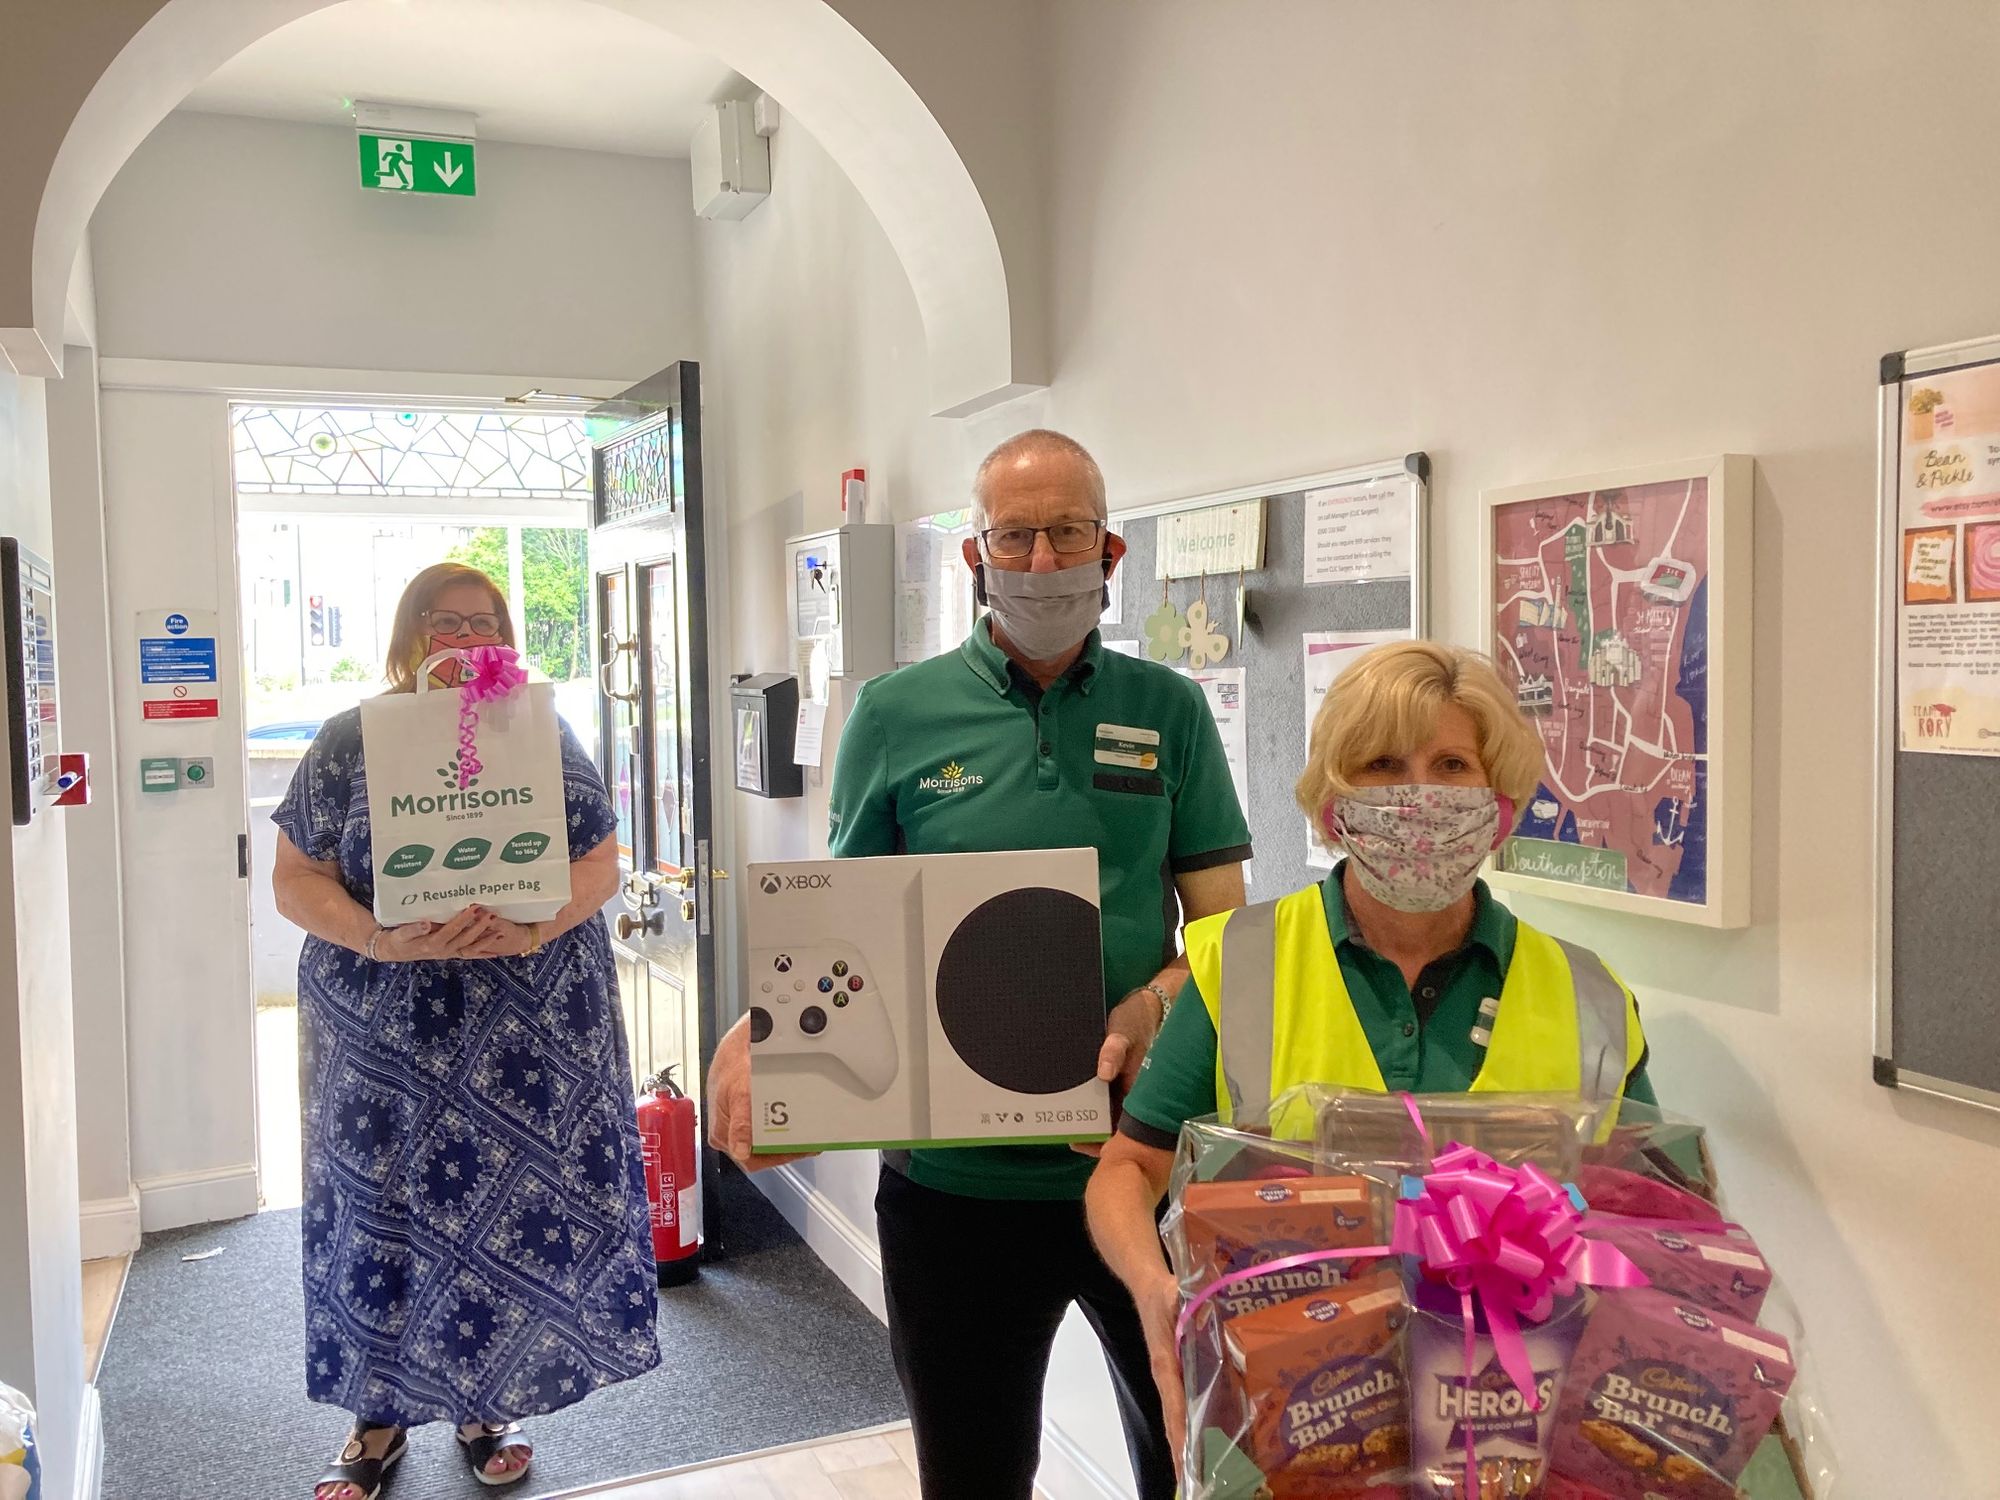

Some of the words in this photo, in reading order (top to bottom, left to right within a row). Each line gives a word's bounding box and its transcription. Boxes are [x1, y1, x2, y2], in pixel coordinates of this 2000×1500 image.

[1924, 450, 1966, 468] Bean
[1931, 469, 1975, 488] Pickle
[1176, 532, 1236, 554] Welcome
[1918, 716, 1952, 738] RORY
[919, 775, 984, 790] Morrisons
[391, 787, 534, 817] Morrisons
[446, 813, 466, 822] Since
[467, 811, 484, 820] 1899
[457, 846, 477, 854] Water
[511, 840, 532, 848] Tested
[533, 840, 542, 848] up
[400, 853, 415, 861] Tear
[453, 854, 481, 863] resistant
[1509, 840, 1621, 884] Southampton
[393, 861, 422, 870] resistant
[785, 874, 832, 890] XBOX
[422, 884, 477, 902] Reusable
[479, 882, 515, 896] Paper
[518, 880, 541, 892] Bag
[836, 963, 845, 974] Y
[821, 979, 830, 991] X
[852, 977, 860, 990] B
[837, 993, 846, 1004] A
[770, 1101, 789, 1126] S
[1035, 1110, 1054, 1123] 512
[1056, 1110, 1074, 1122] GB
[1076, 1109, 1099, 1121] SSD
[1337, 1215, 1344, 1226] 6
[1287, 1369, 1400, 1430] Brunch
[1601, 1373, 1733, 1436] Brunch
[1591, 1398, 1664, 1429] Bar
[1289, 1409, 1348, 1450] Bar
